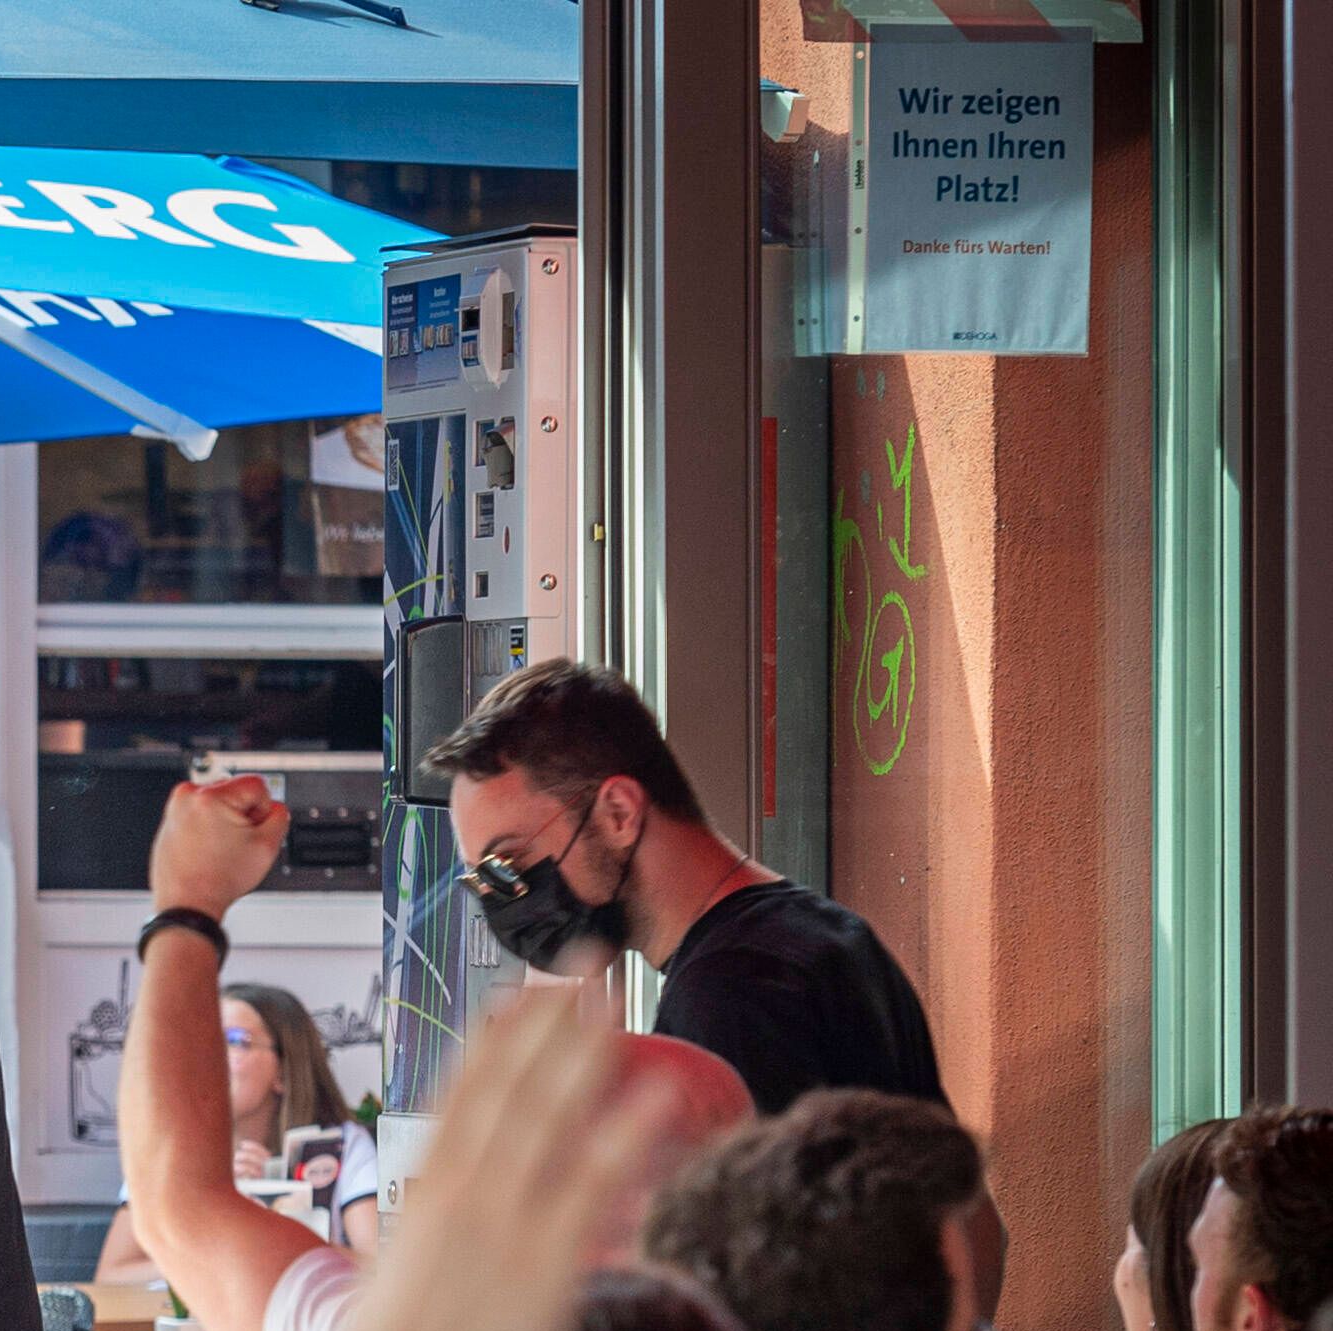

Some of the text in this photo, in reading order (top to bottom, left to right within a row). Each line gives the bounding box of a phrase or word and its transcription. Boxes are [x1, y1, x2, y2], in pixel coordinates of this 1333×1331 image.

[898, 87, 1061, 124] Wir zeigen
[893, 130, 1066, 159] Ihnen Ihren
[936, 174, 1020, 203] Platz!
[903, 239, 1051, 255] Danke fürs Warten!
